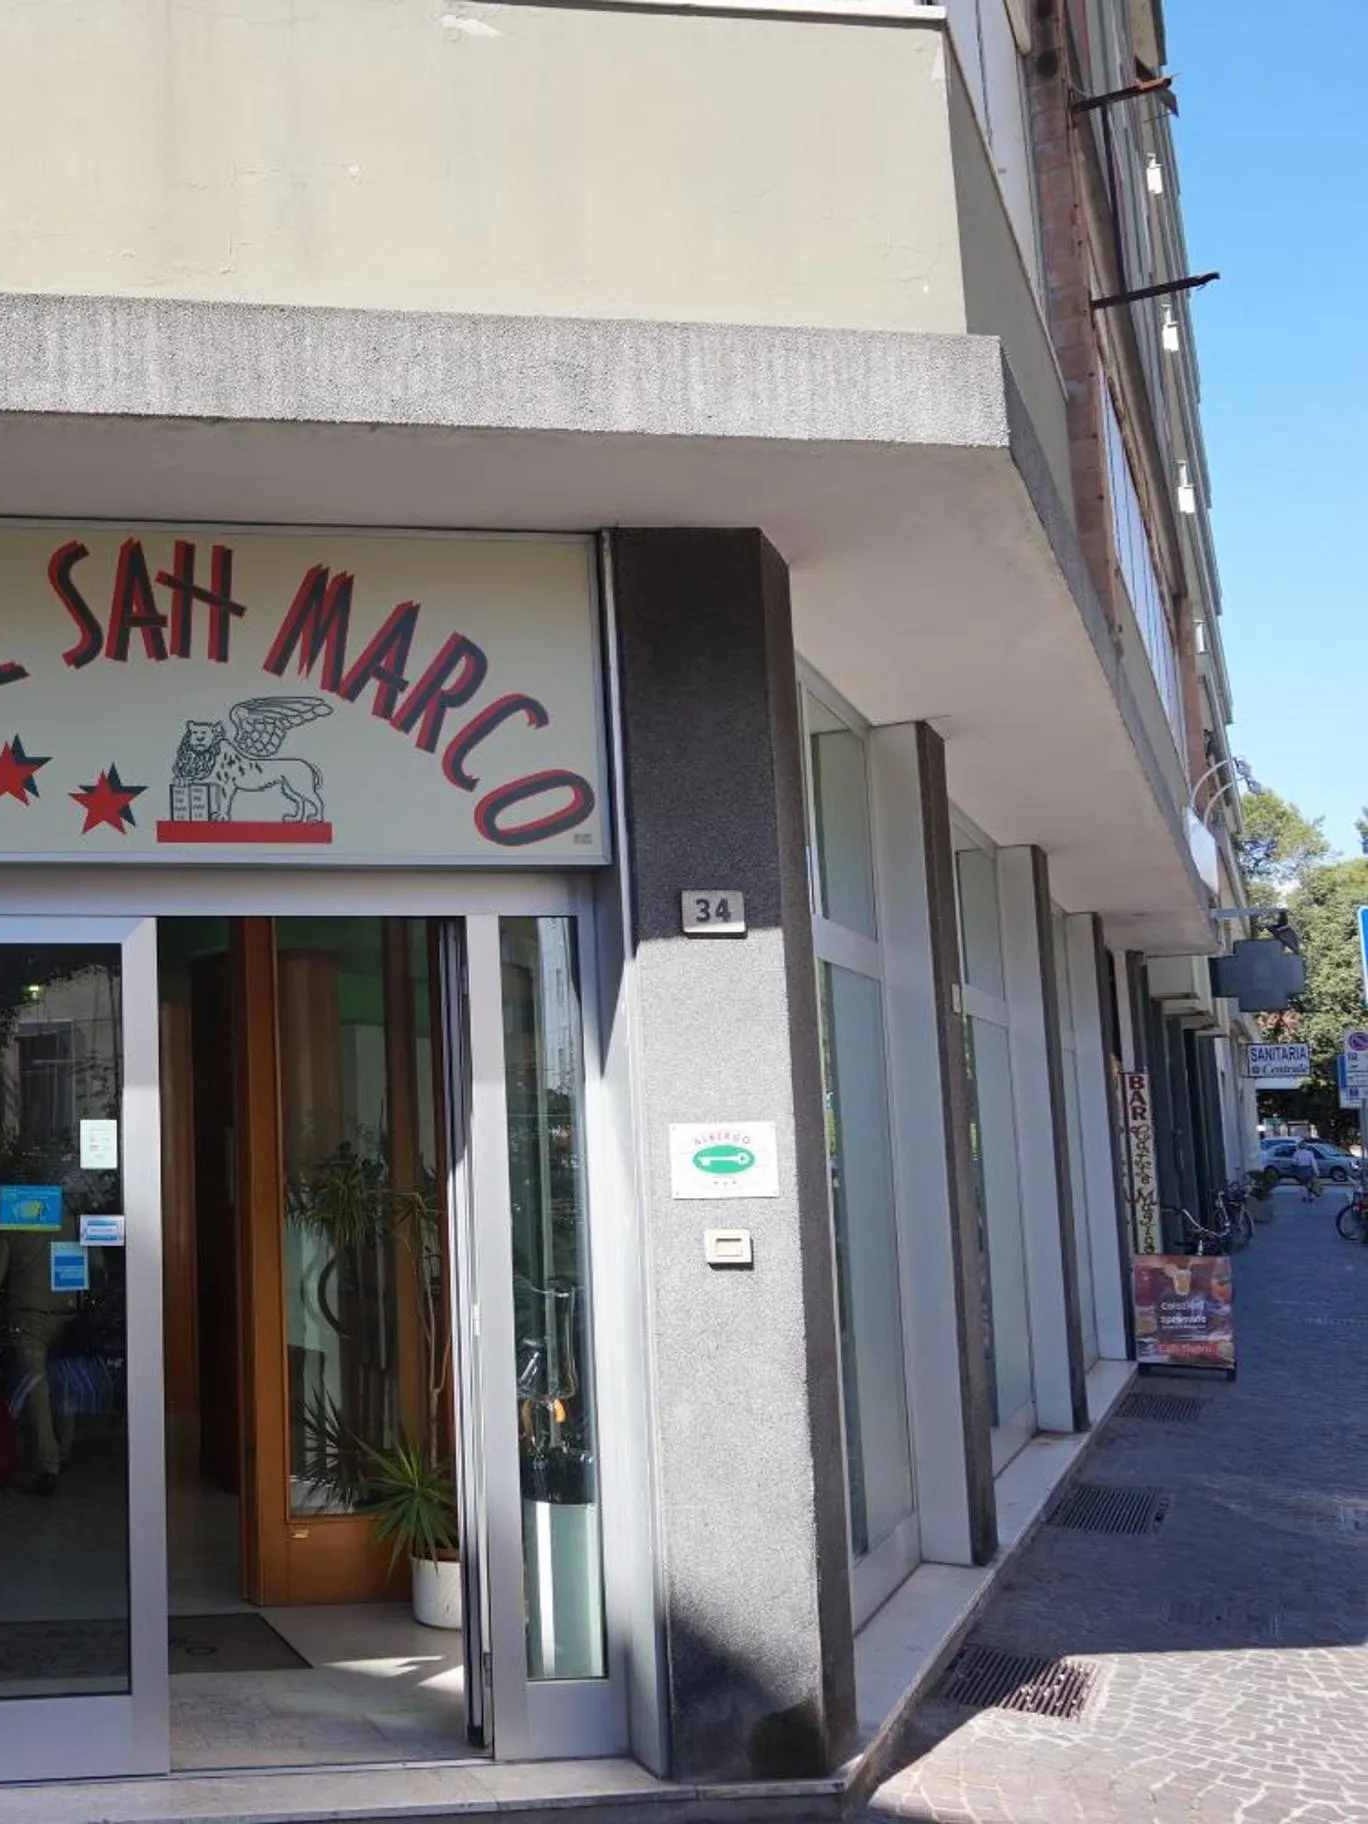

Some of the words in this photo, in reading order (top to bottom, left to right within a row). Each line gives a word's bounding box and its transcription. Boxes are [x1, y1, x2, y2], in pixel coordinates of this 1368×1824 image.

[262, 562, 596, 847] MARCO
[695, 897, 732, 923] 34
[1250, 1046, 1308, 1062] SANITARIA
[1128, 1075, 1147, 1121] BAR
